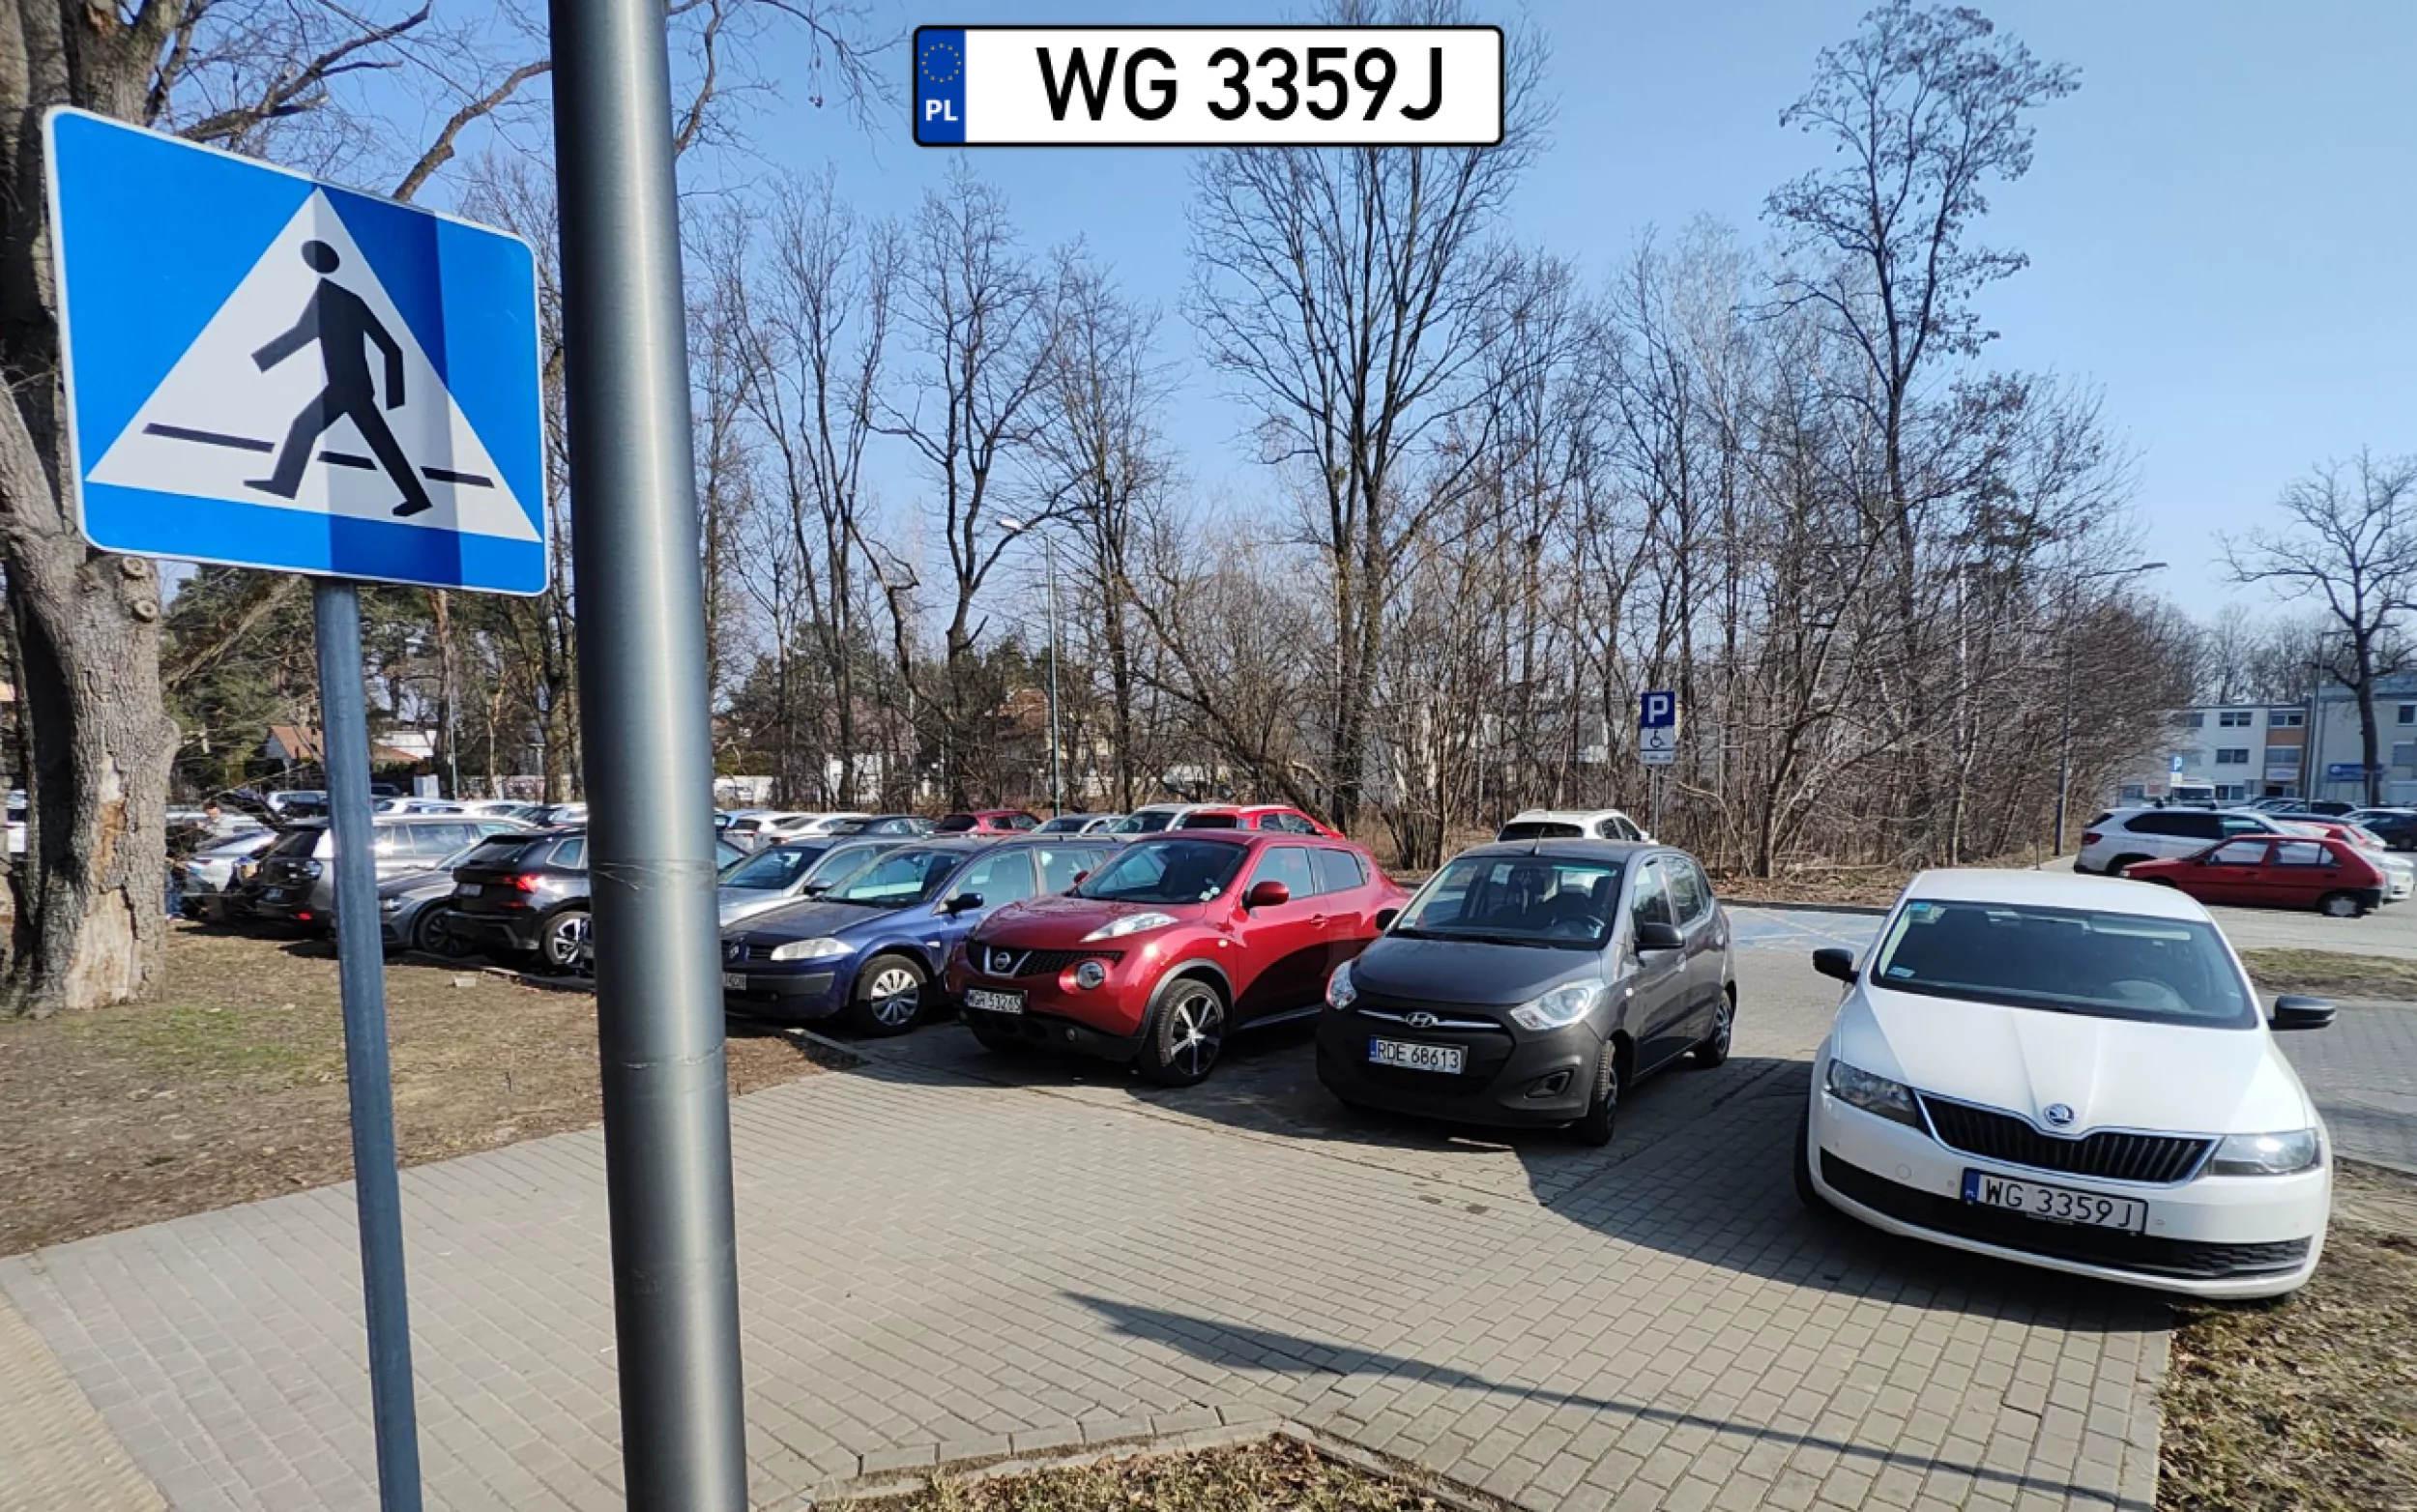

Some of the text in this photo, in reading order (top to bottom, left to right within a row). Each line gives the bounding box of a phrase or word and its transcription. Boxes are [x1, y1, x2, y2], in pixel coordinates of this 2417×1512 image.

[1648, 695, 1669, 724] P
[2173, 756, 2183, 771] P
[1377, 1041, 1460, 1069] RDE 68613
[1985, 1179, 2133, 1228] WG 3359J
